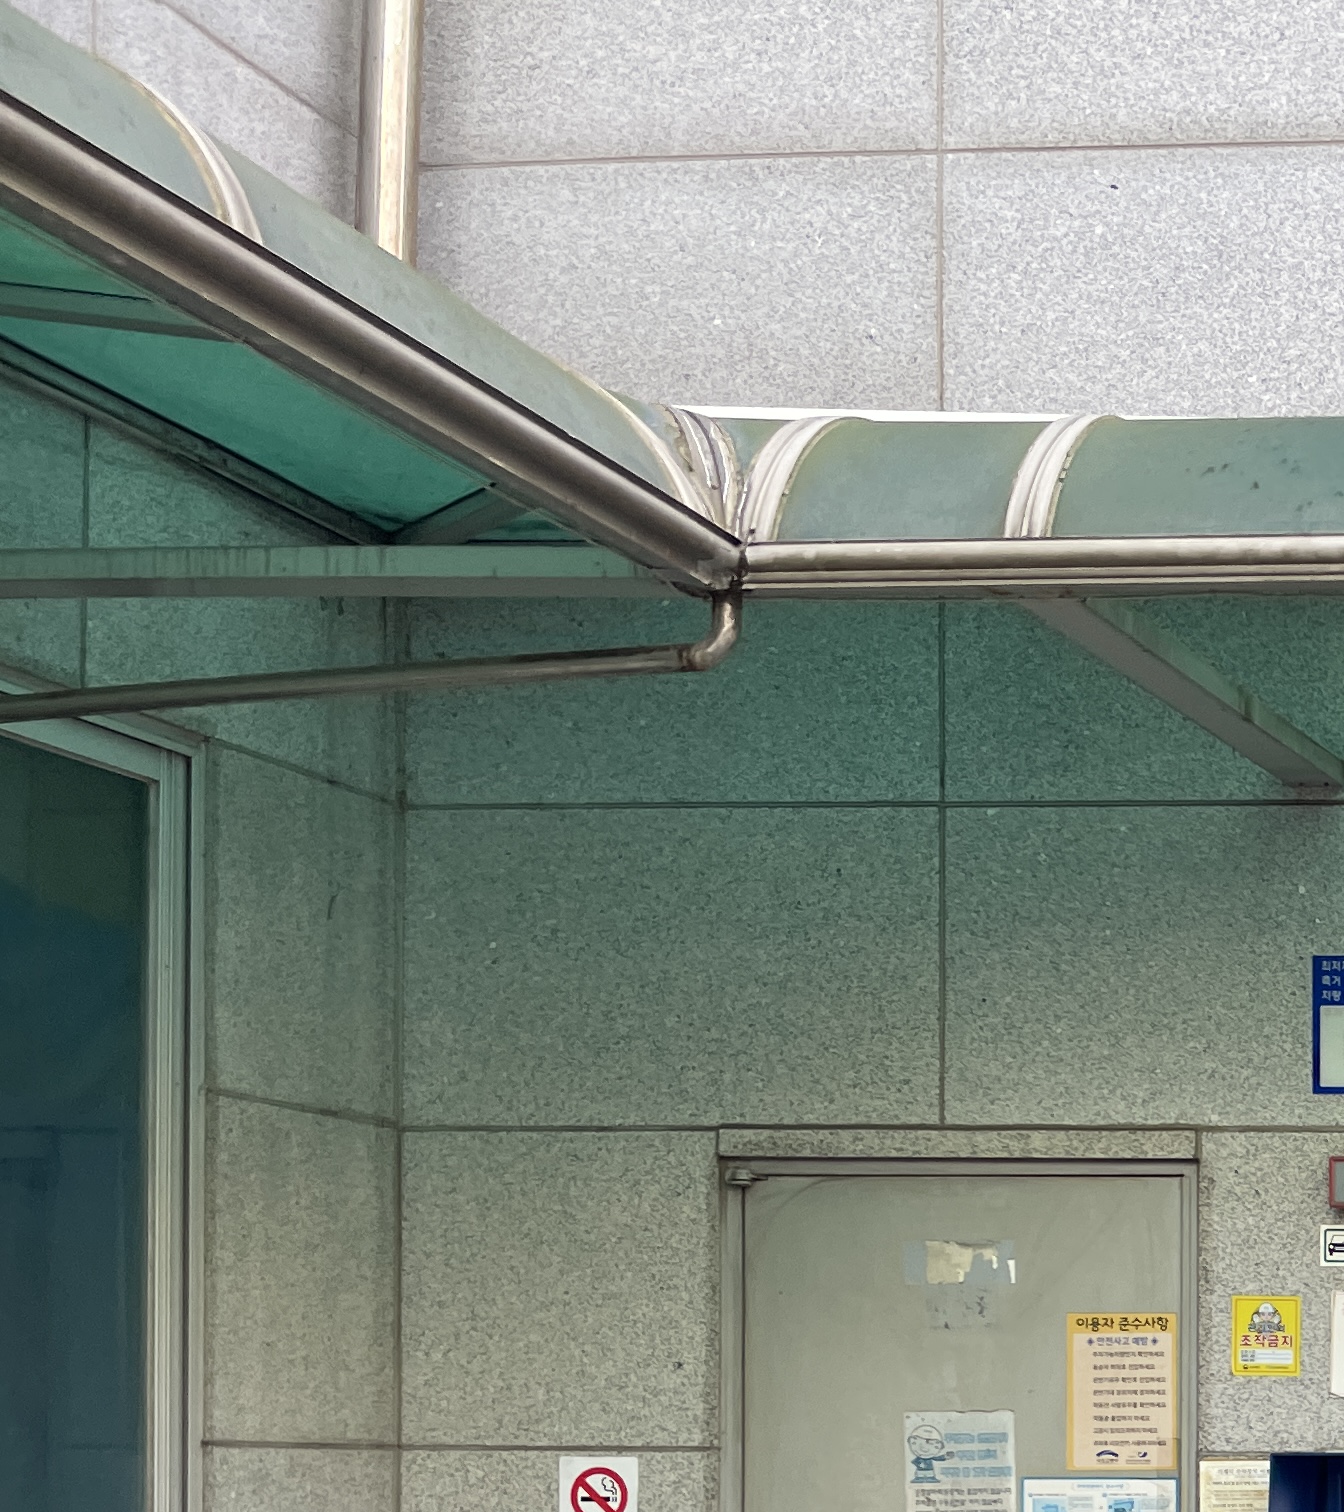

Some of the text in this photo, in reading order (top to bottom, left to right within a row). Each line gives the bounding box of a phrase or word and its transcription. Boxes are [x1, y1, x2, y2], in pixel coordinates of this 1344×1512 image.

[1076, 1316, 1169, 1332] 이용자 준수사항
[1240, 1334, 1293, 1347] 조작금지
